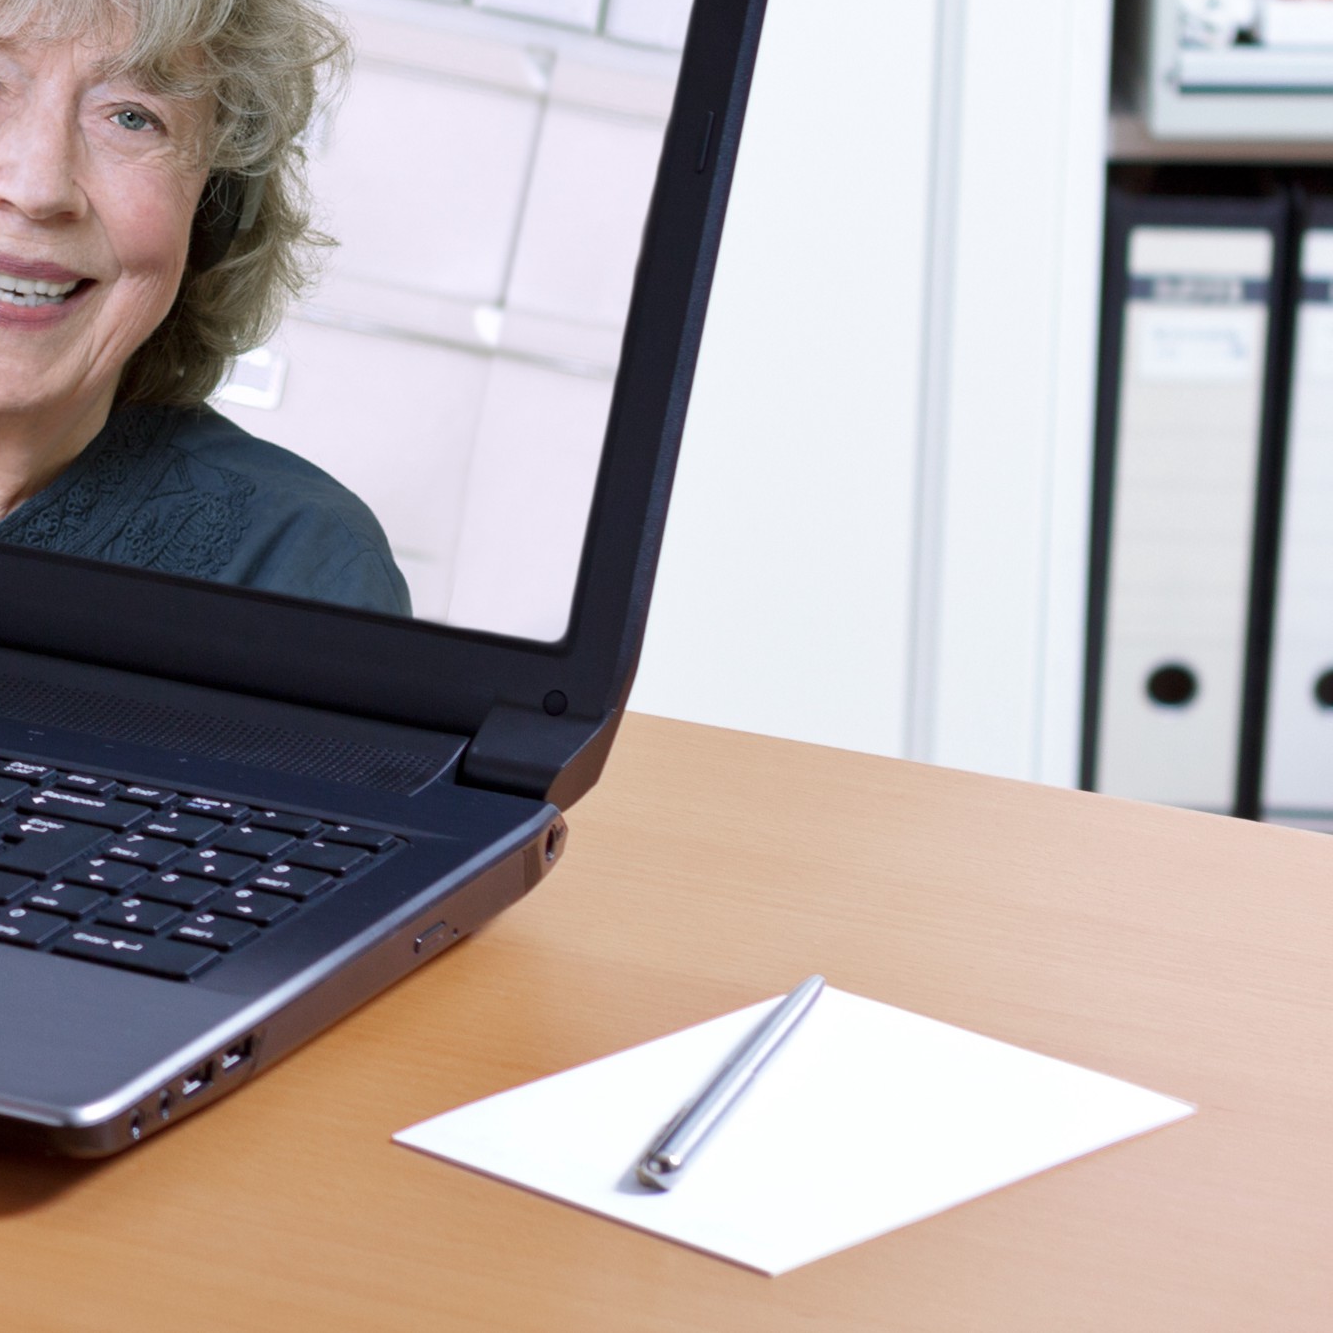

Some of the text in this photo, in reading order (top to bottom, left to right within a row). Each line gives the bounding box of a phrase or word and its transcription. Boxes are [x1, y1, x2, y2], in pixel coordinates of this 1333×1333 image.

[41, 790, 106, 806] Backspace
[27, 818, 65, 830] Enter
[273, 865, 290, 873] 9
[162, 874, 179, 882] 5
